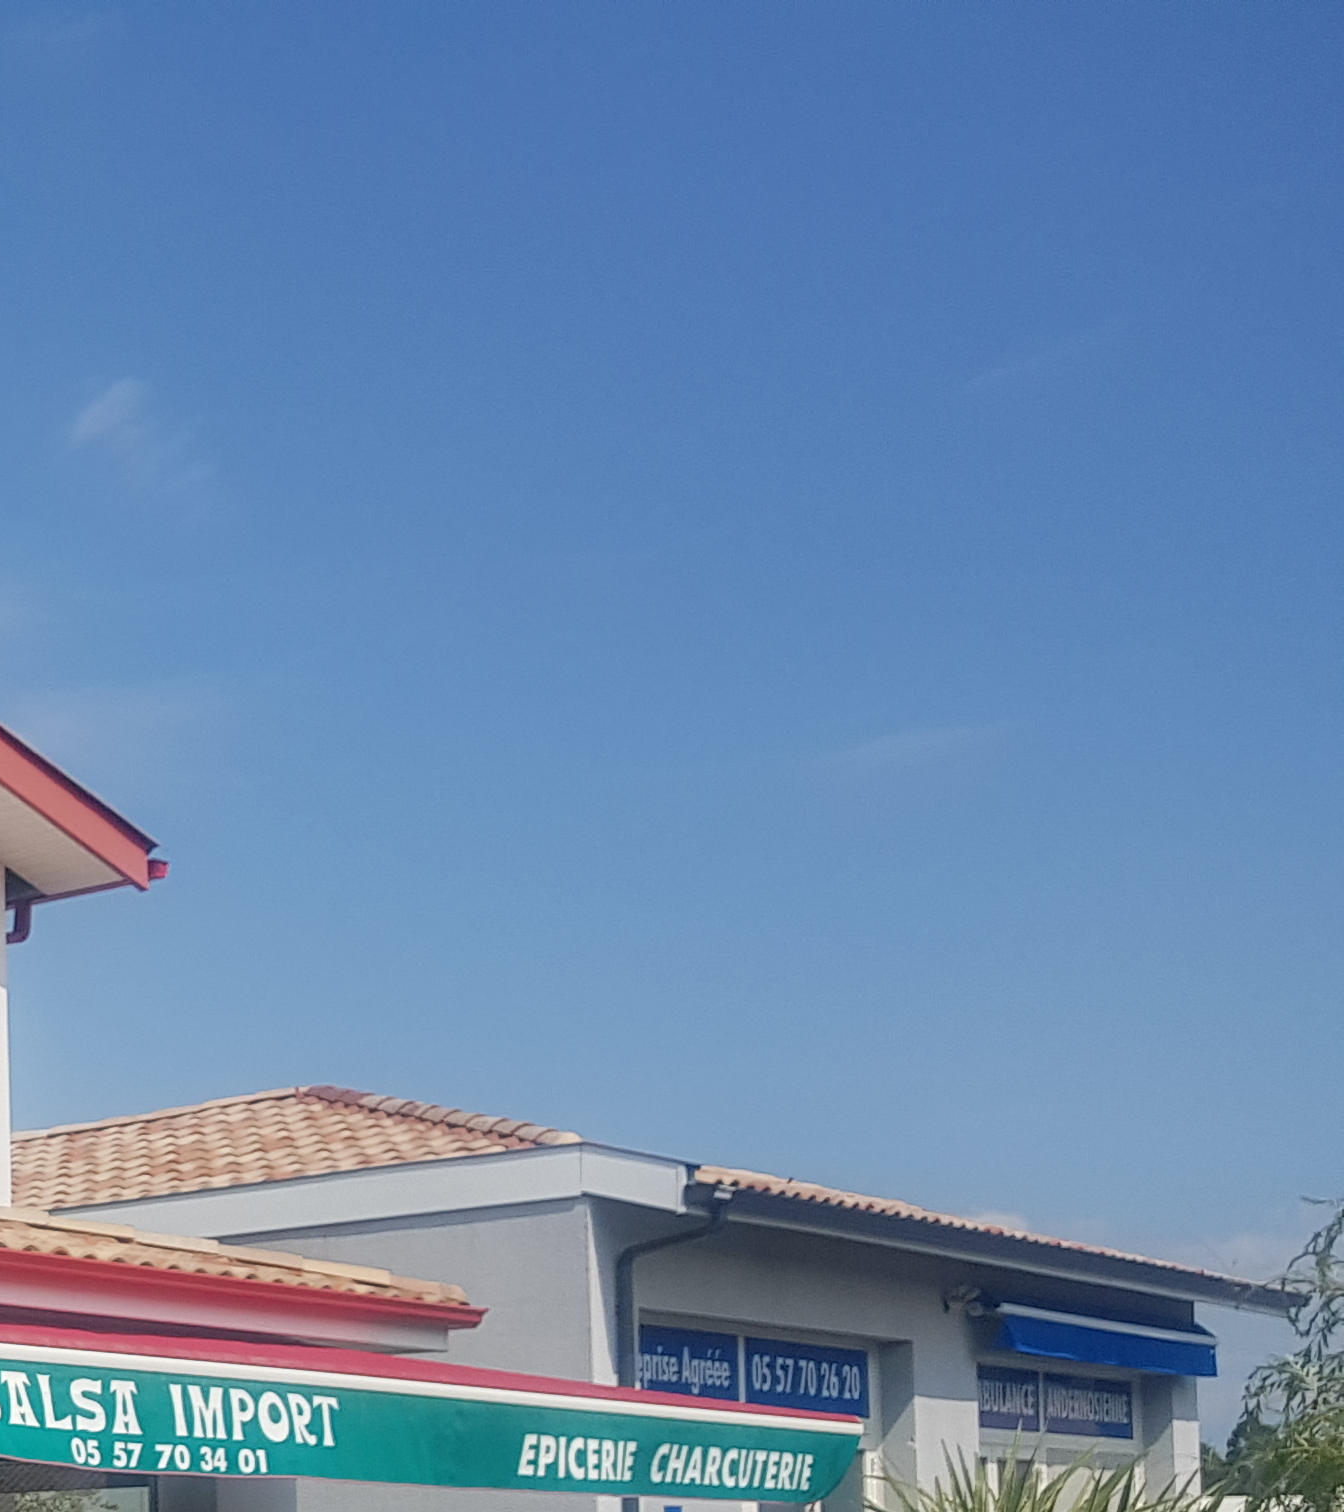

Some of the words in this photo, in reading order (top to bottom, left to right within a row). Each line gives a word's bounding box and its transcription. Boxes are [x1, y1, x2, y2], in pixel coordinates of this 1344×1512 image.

[681, 1346, 731, 1394] Agréée
[751, 1353, 772, 1392] 05
[775, 1357, 794, 1393] 57
[798, 1360, 817, 1396] 70
[821, 1362, 840, 1398] 26
[842, 1364, 861, 1400] 20
[169, 1383, 340, 1447] IMPORT
[71, 1437, 100, 1466] 05
[112, 1441, 143, 1468] 57
[155, 1443, 190, 1470] 70
[200, 1446, 227, 1472] 34
[237, 1448, 268, 1474] 01
[517, 1433, 638, 1482] EPICERIE
[650, 1443, 814, 1491] CHARCUTERIE
